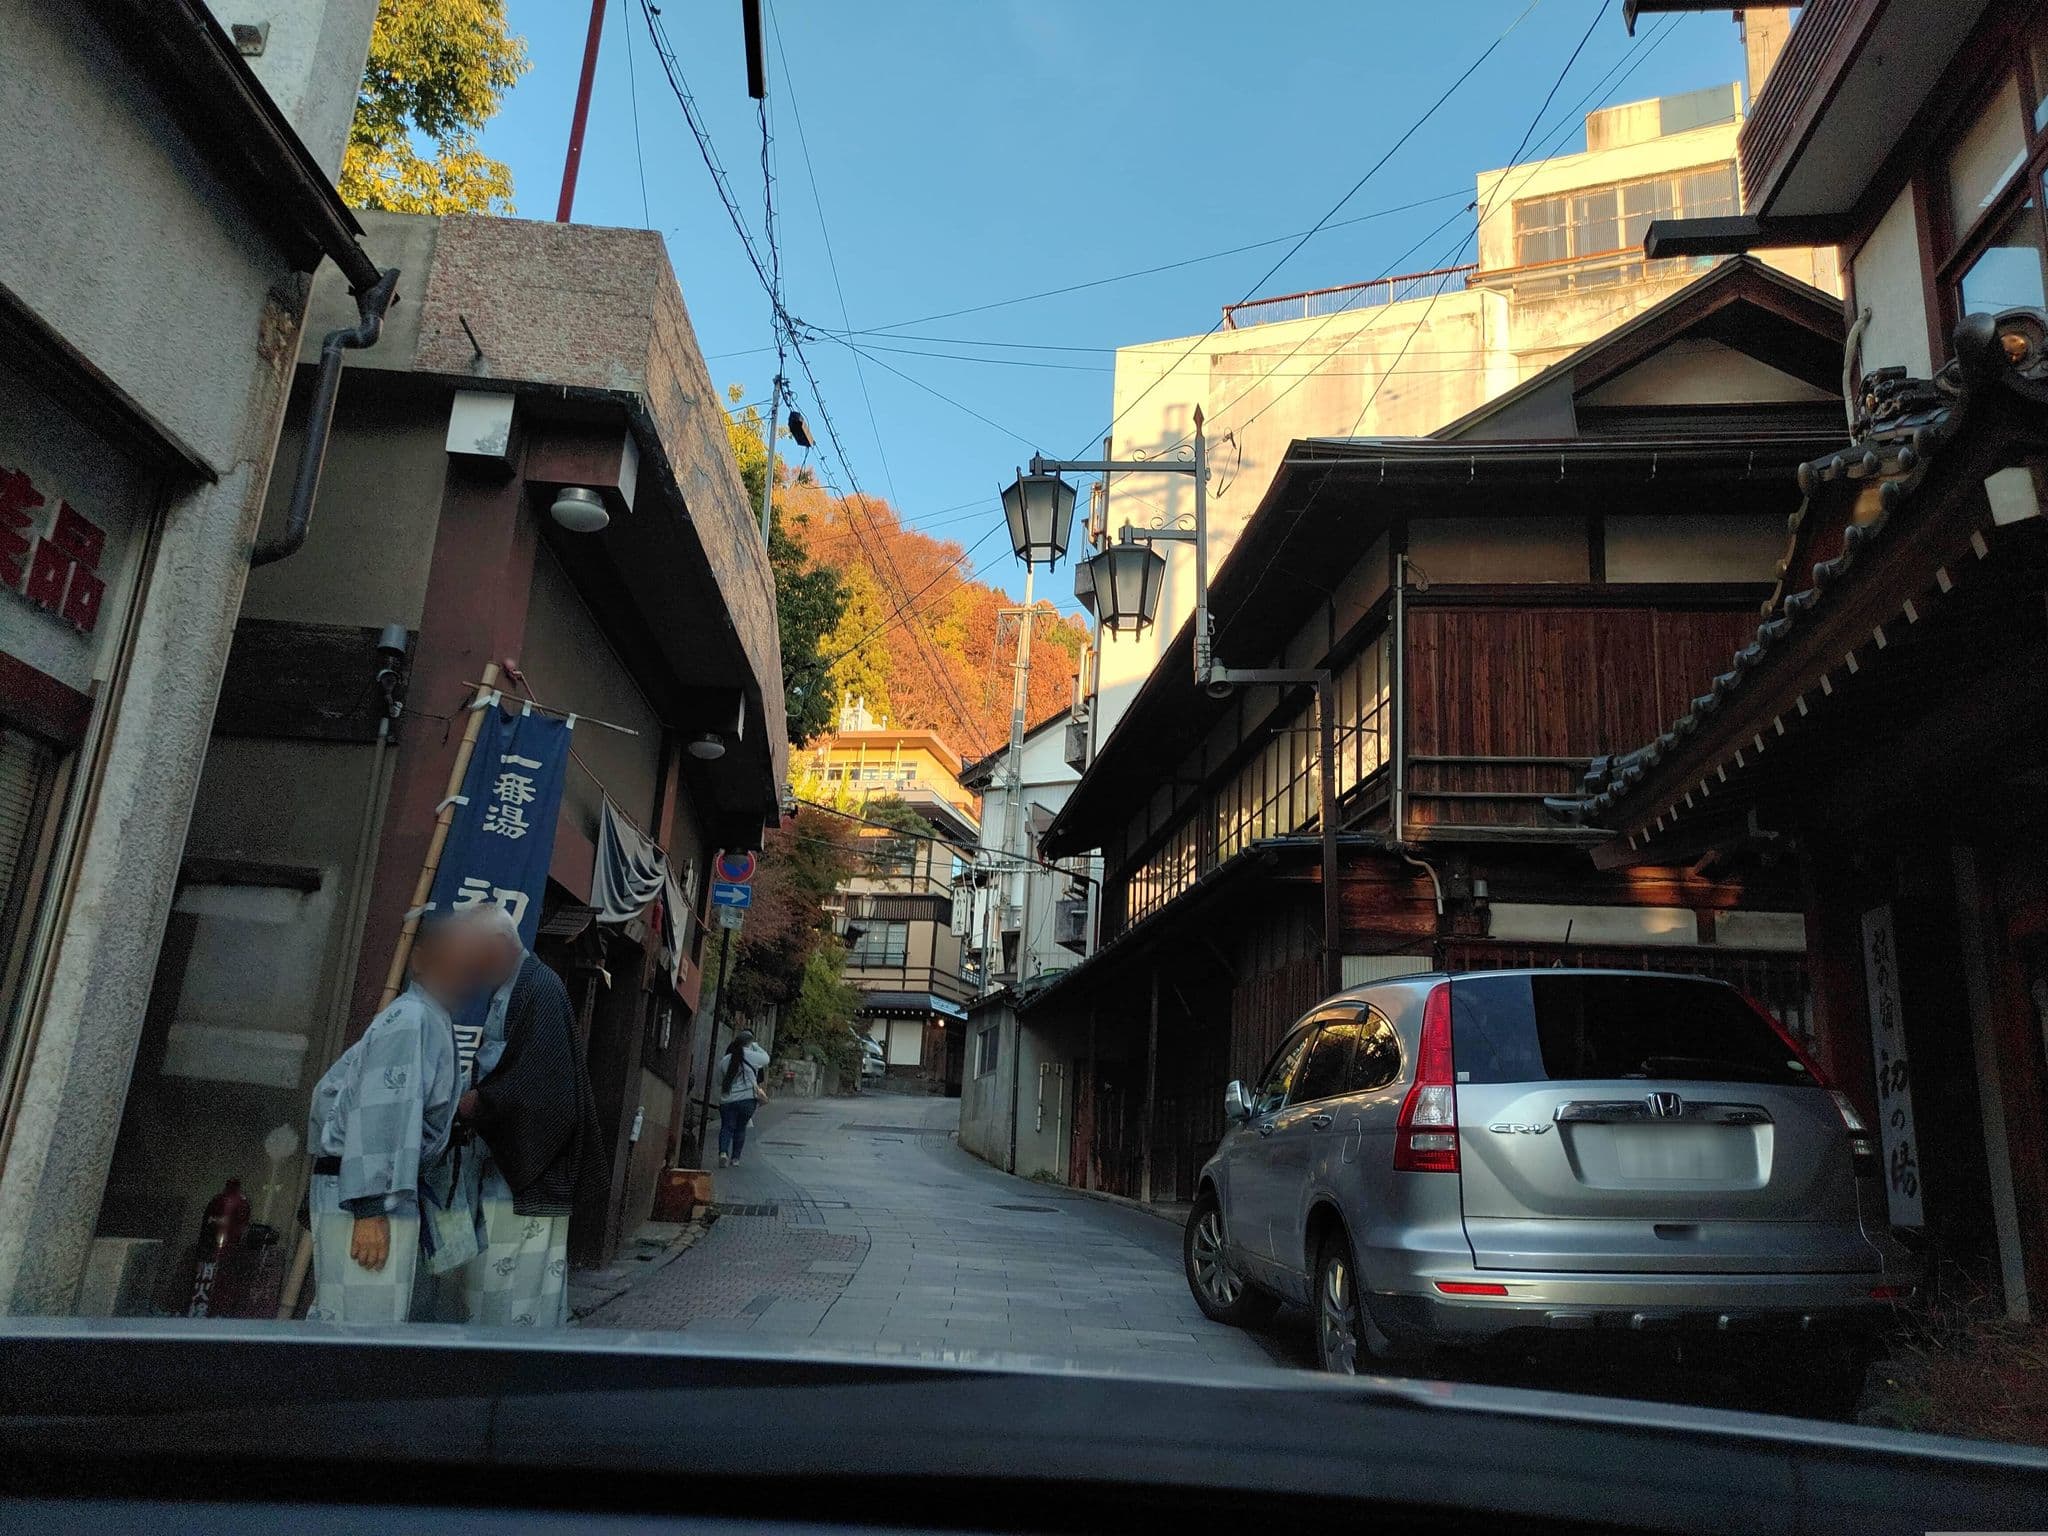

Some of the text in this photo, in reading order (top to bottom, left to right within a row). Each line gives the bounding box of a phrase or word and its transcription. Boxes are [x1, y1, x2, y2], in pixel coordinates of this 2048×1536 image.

[483, 754, 543, 839] 一番湯
[1489, 1122, 1554, 1135] CR-V
